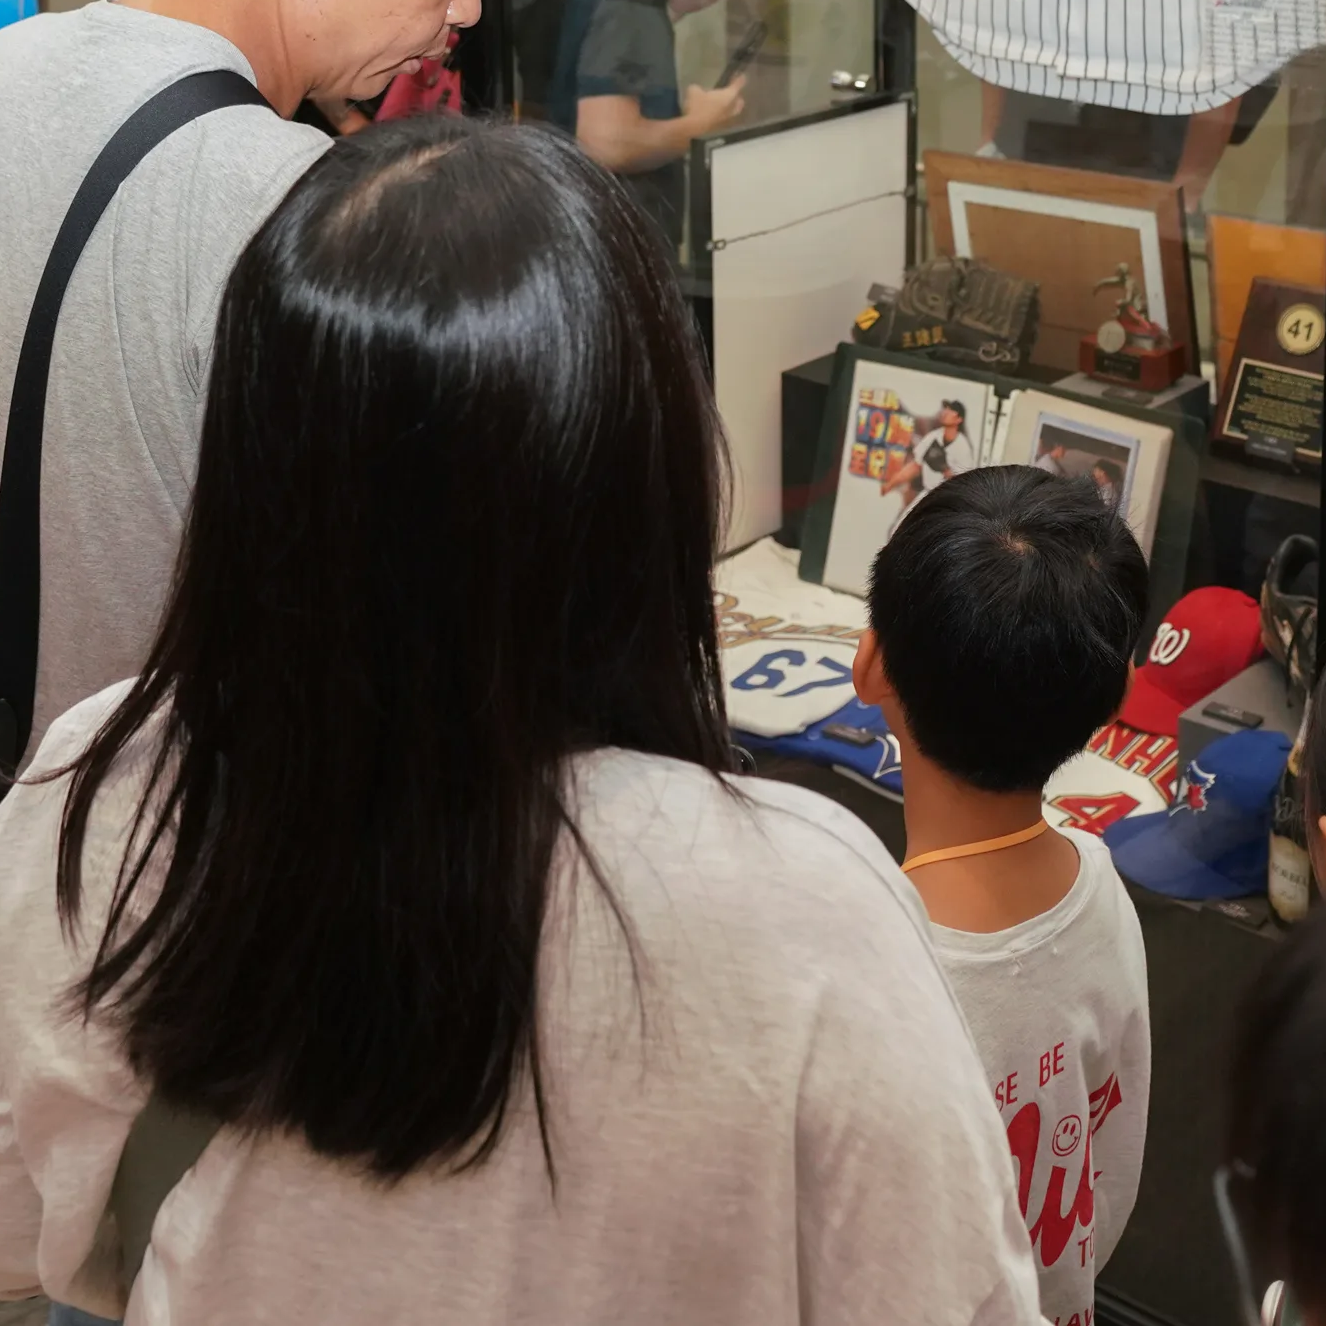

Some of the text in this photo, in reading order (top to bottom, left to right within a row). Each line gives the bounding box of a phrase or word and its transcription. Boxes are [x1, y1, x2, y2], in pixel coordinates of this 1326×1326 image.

[1287, 318, 1315, 342] 41
[1149, 622, 1191, 666] W
[730, 649, 854, 697] 67
[1039, 1042, 1065, 1087] BE
